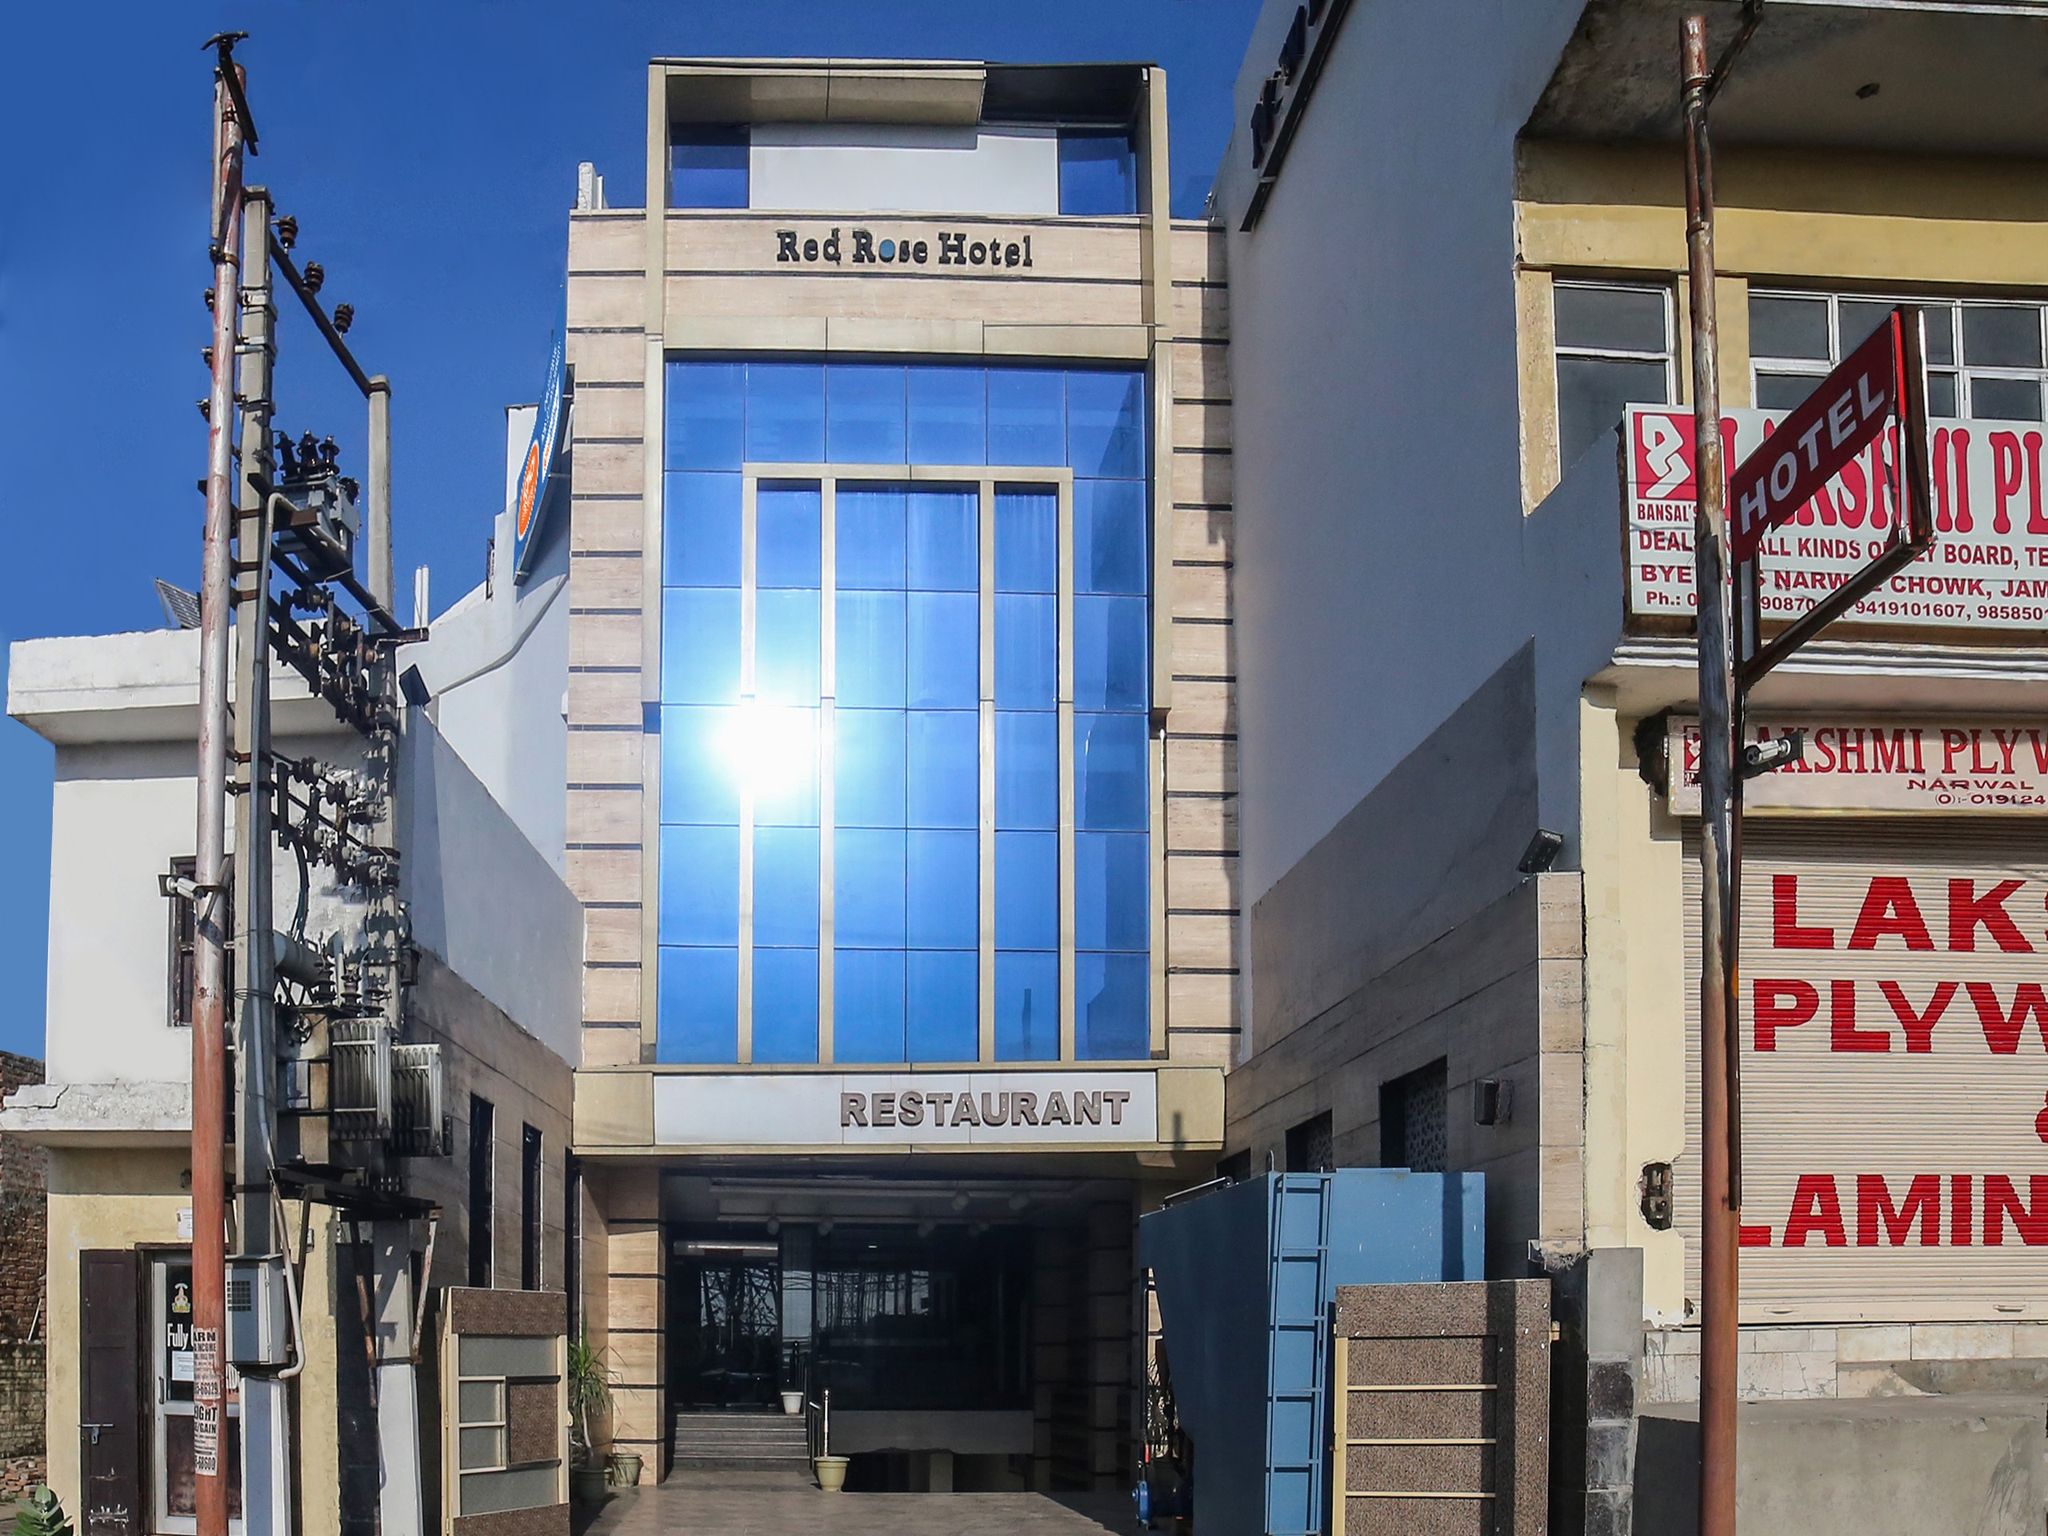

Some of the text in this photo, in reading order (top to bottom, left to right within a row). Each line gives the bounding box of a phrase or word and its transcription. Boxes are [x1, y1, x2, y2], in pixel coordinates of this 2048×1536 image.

[776, 228, 1033, 267] Red Rose Hotel
[1740, 373, 1885, 534] HOTEL
[1639, 530, 1696, 551] DEAL
[1798, 538, 1861, 560] KINDS
[1944, 543, 2019, 570] BOARD,
[1641, 565, 1692, 584] BYE
[1890, 576, 1992, 600] CHOWK,
[1646, 591, 1681, 606] Ph.:
[1977, 605, 2048, 620] 985850
[1907, 778, 2034, 791] NARWAL
[1772, 874, 2048, 953] LAK
[840, 1091, 1130, 1126] RESTAURANT
[167, 1323, 189, 1351] Fully
